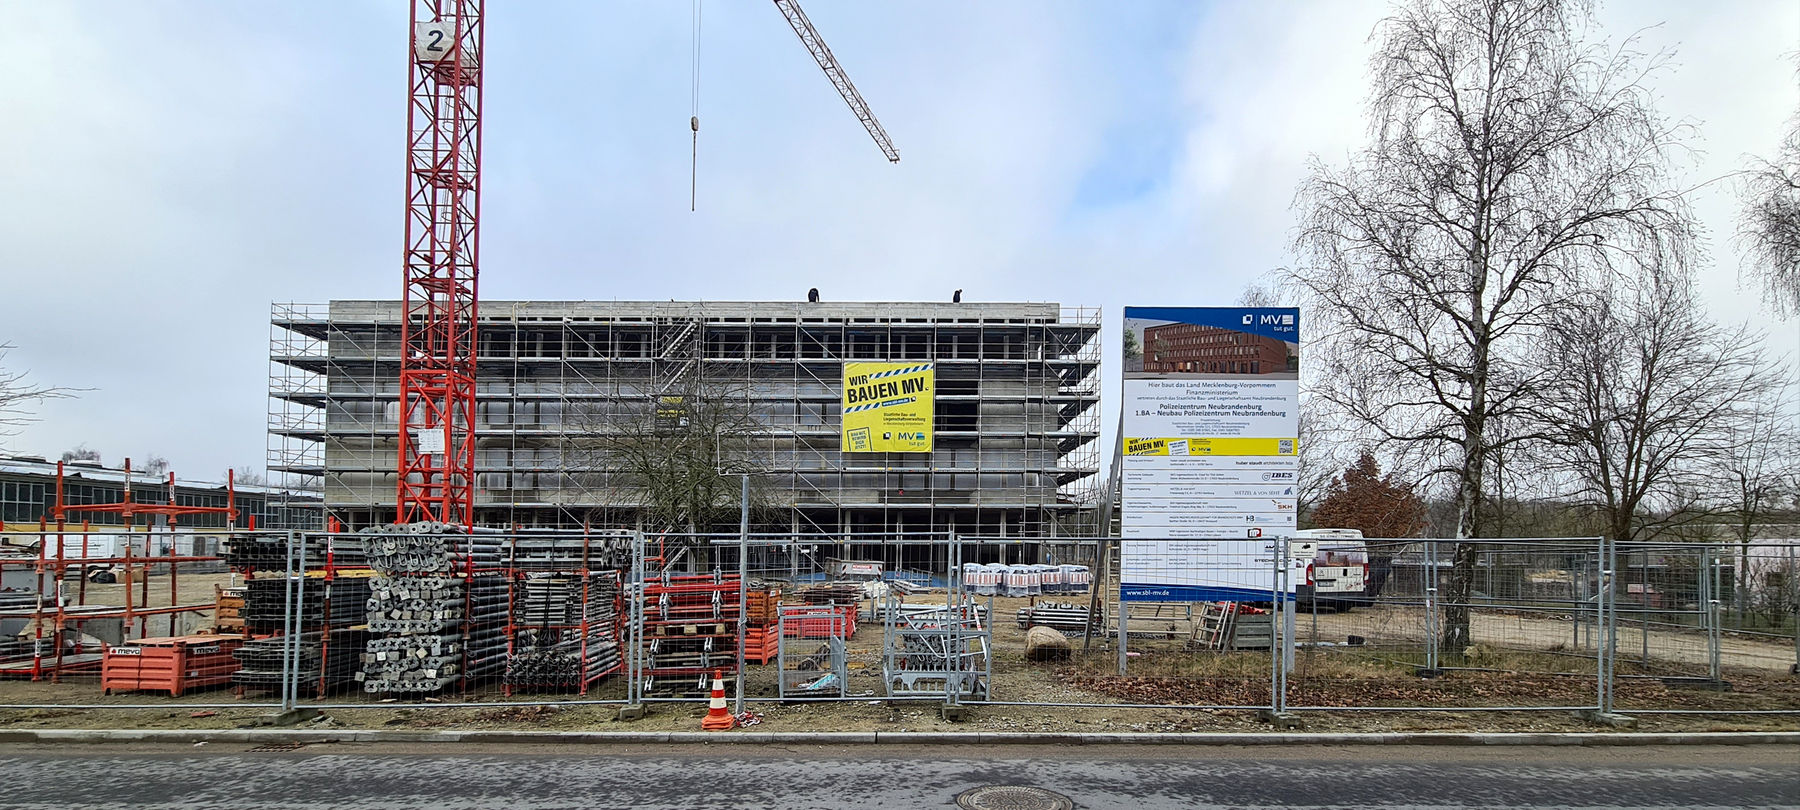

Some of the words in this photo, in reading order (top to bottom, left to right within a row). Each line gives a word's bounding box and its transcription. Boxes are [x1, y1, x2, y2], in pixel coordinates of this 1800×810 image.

[427, 30, 444, 51] 2
[1261, 314, 1281, 325] MV
[849, 375, 868, 386] WIR
[848, 382, 898, 403] BAUEN
[1128, 442, 1152, 452] BAUEN
